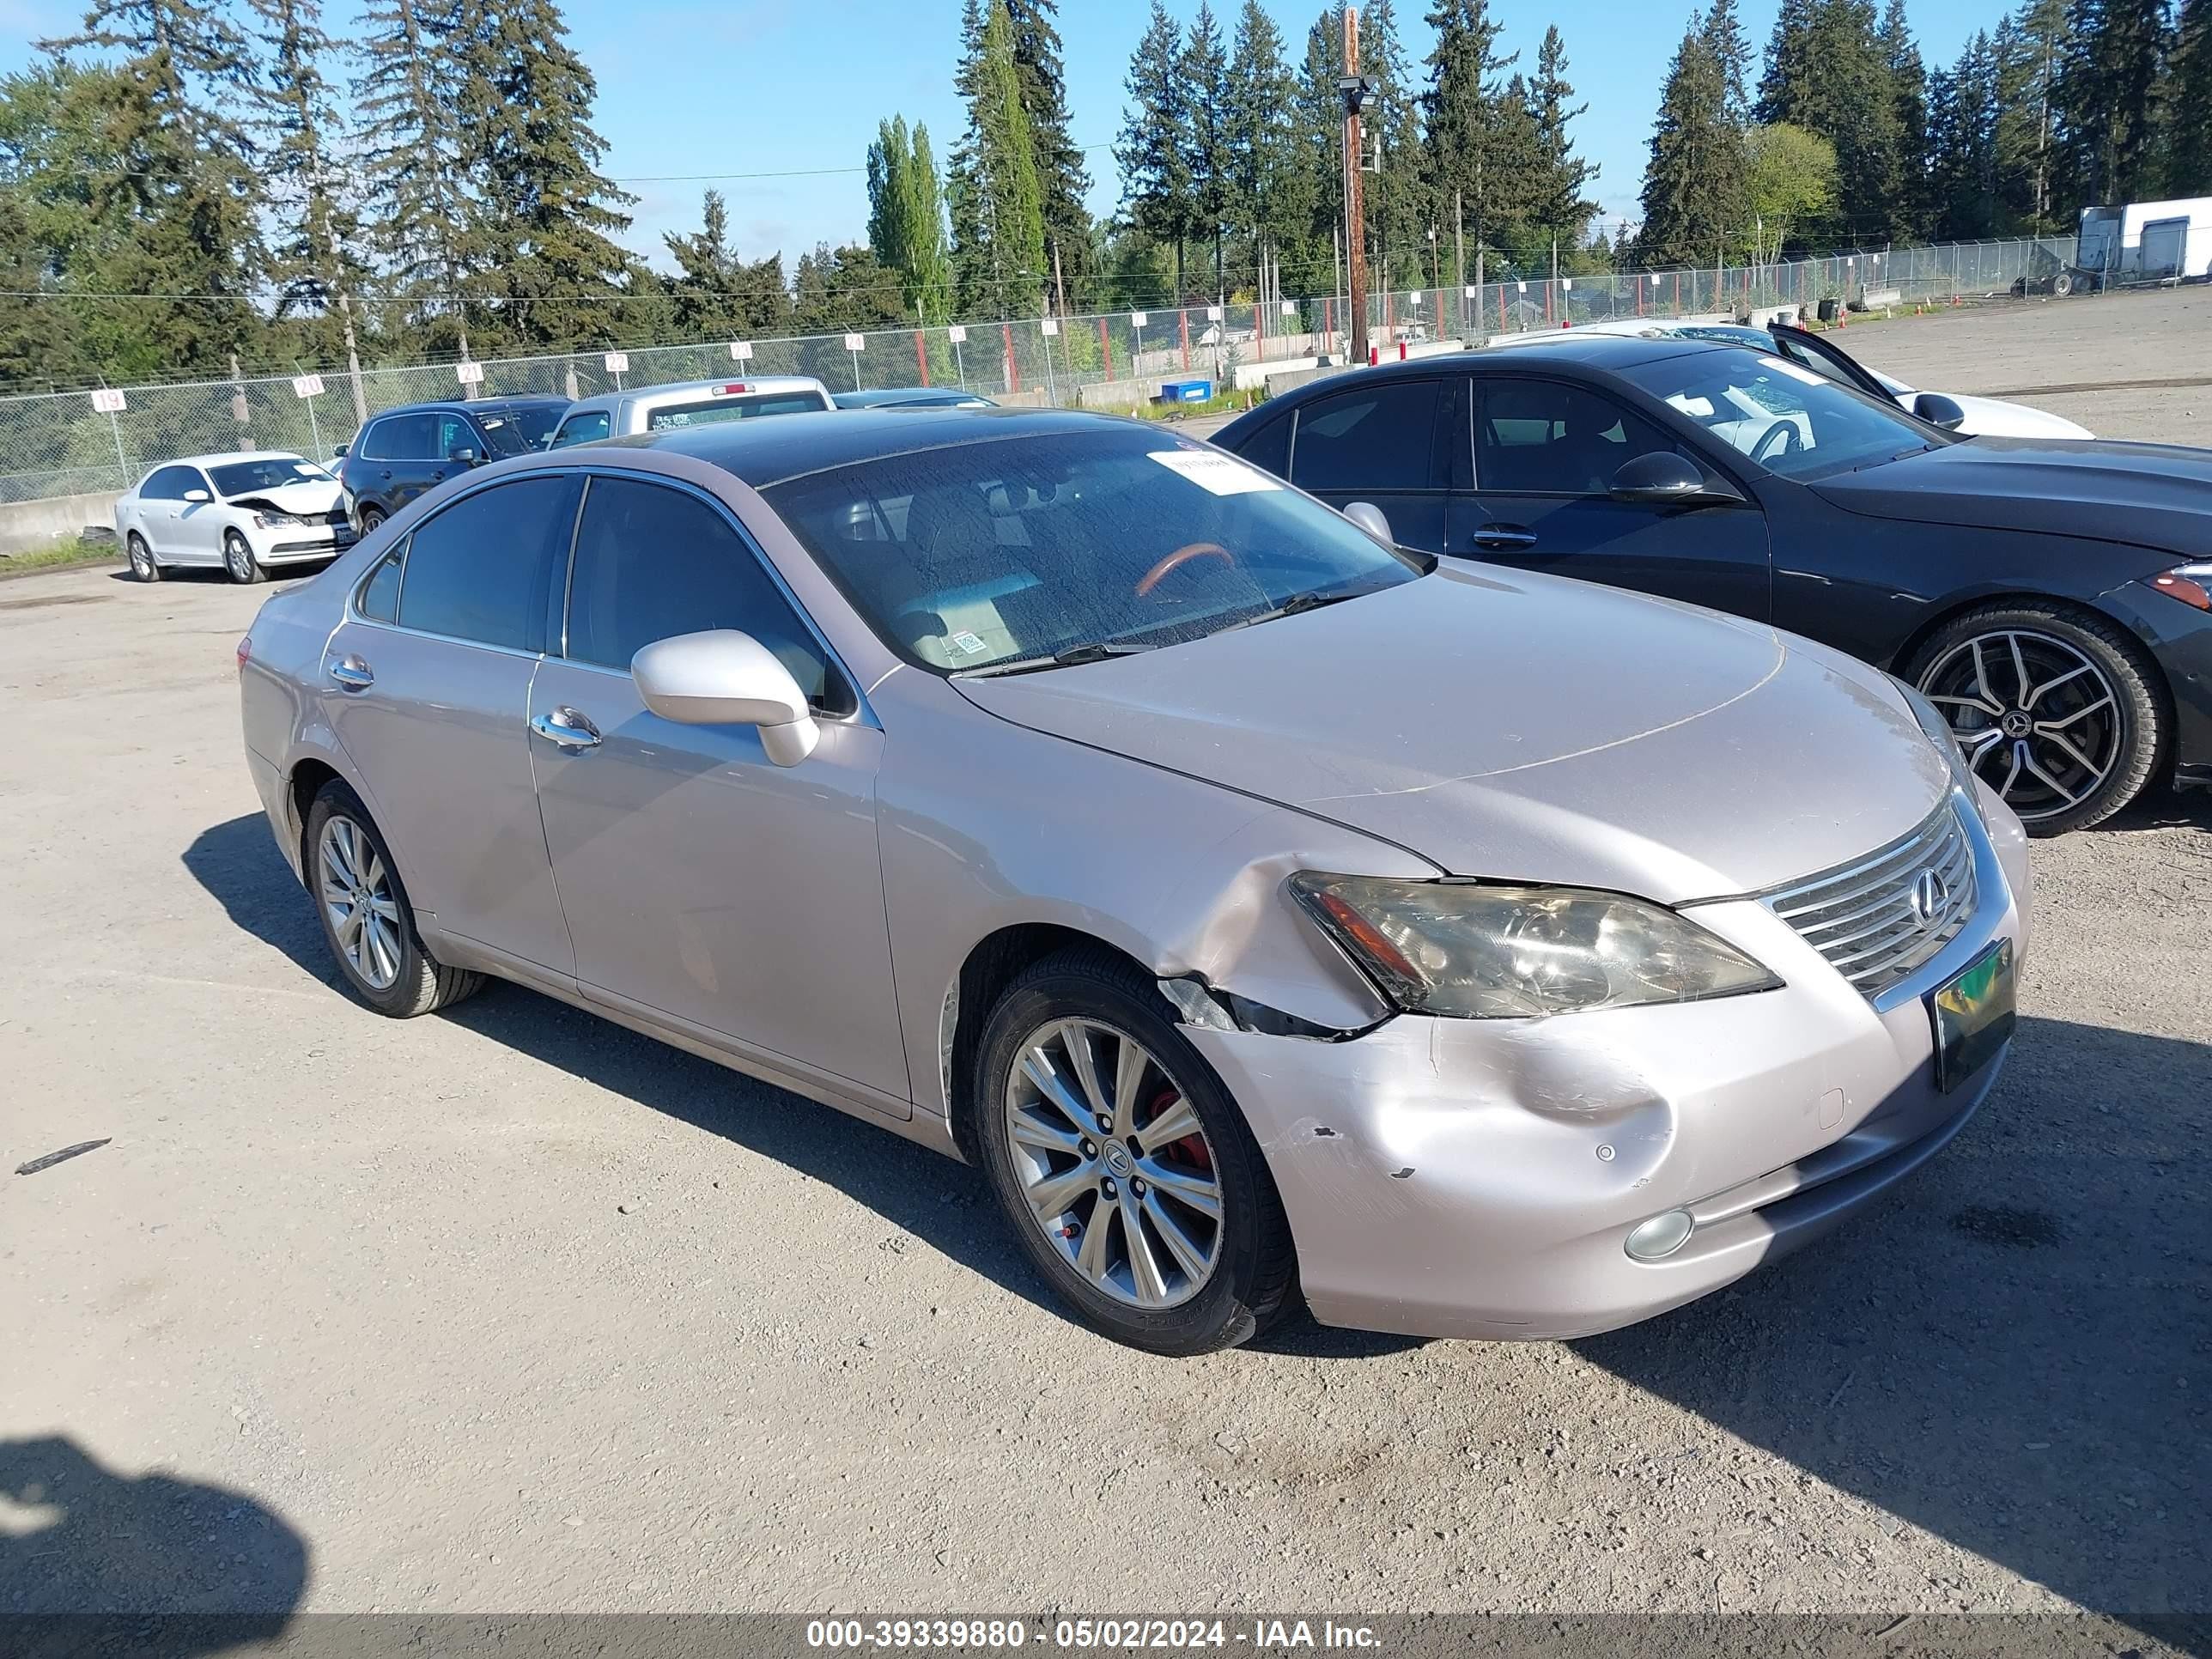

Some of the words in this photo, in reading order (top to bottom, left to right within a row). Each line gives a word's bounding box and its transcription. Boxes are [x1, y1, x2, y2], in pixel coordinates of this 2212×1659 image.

[951, 328, 963, 341] 25
[1043, 322, 1055, 334] 26
[848, 336, 861, 348] 24
[733, 343, 750, 357] 23
[608, 356, 625, 370] 22
[462, 366, 479, 380] 21
[297, 377, 320, 394] 20
[99, 392, 119, 410] 19
